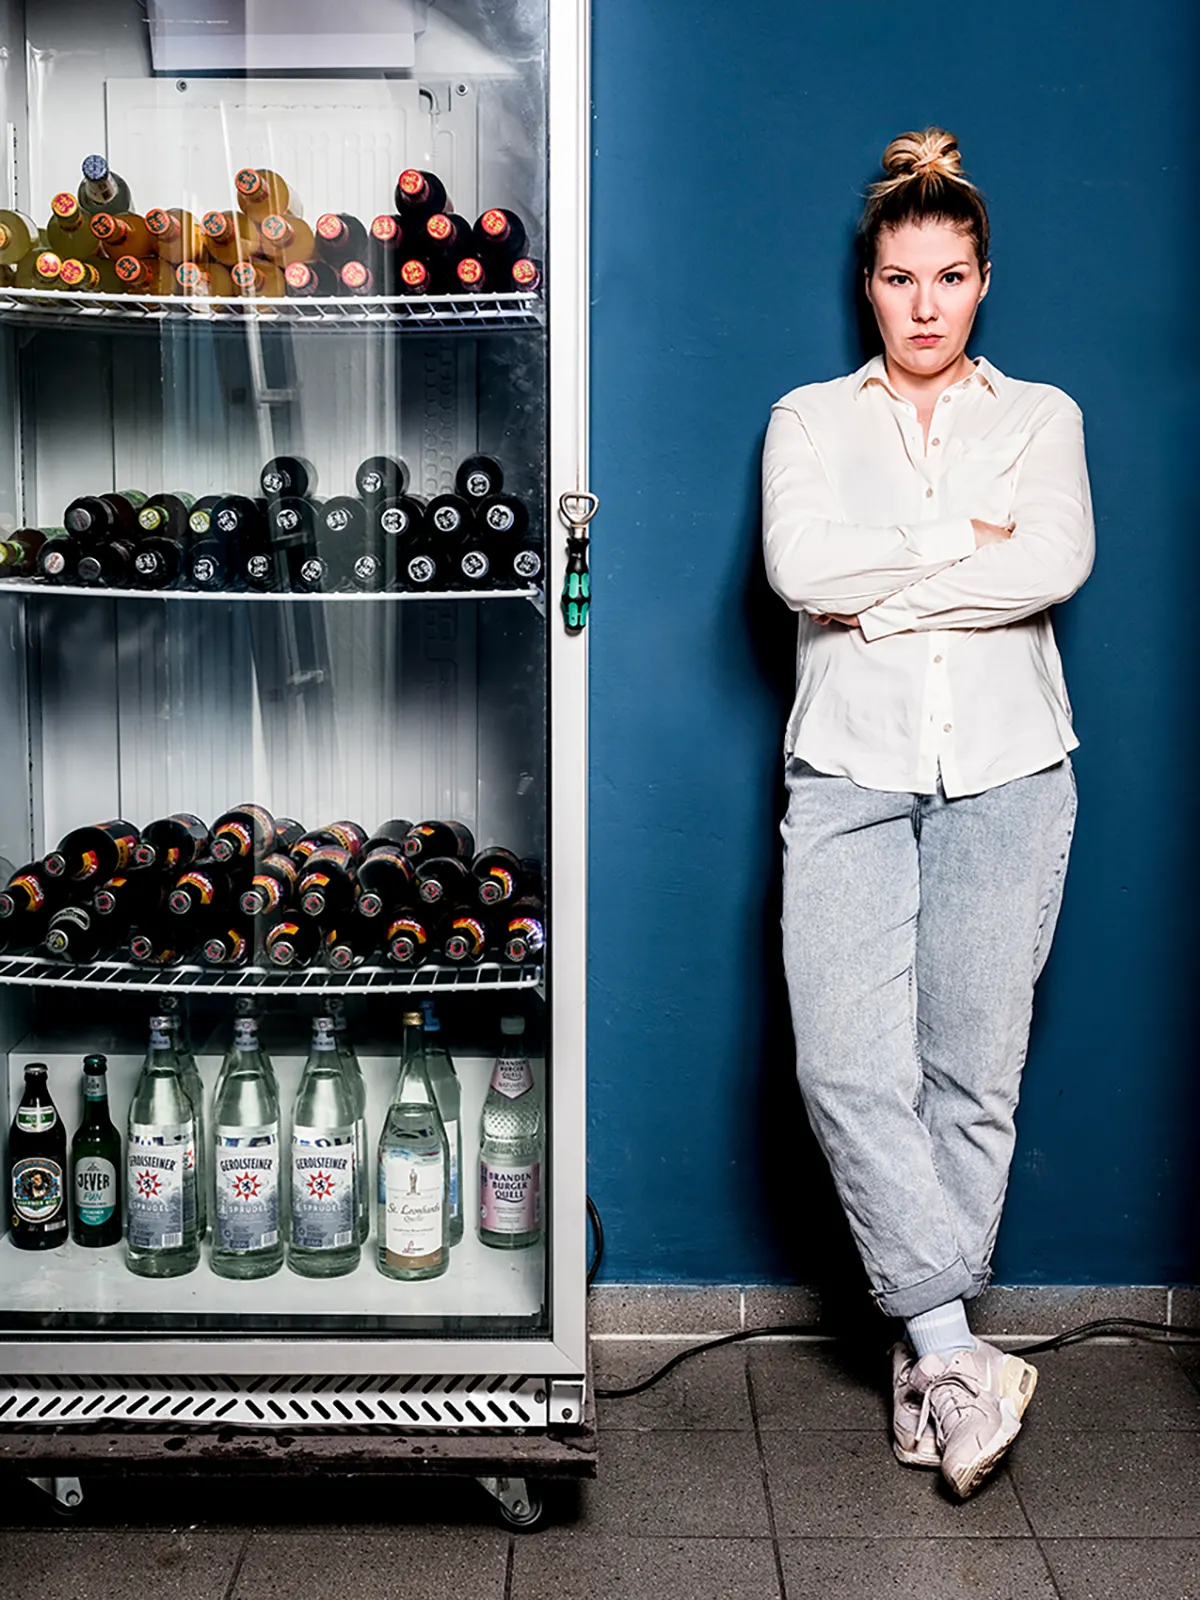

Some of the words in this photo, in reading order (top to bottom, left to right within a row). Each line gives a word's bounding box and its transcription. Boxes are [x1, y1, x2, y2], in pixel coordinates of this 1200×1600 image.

[220, 1157, 273, 1172] GEROLSTEINER
[295, 1156, 348, 1170] GEROLSTEINER
[77, 1172, 110, 1191] JEVER
[489, 1172, 532, 1182] BRANDEN
[492, 1181, 528, 1190] BURGER
